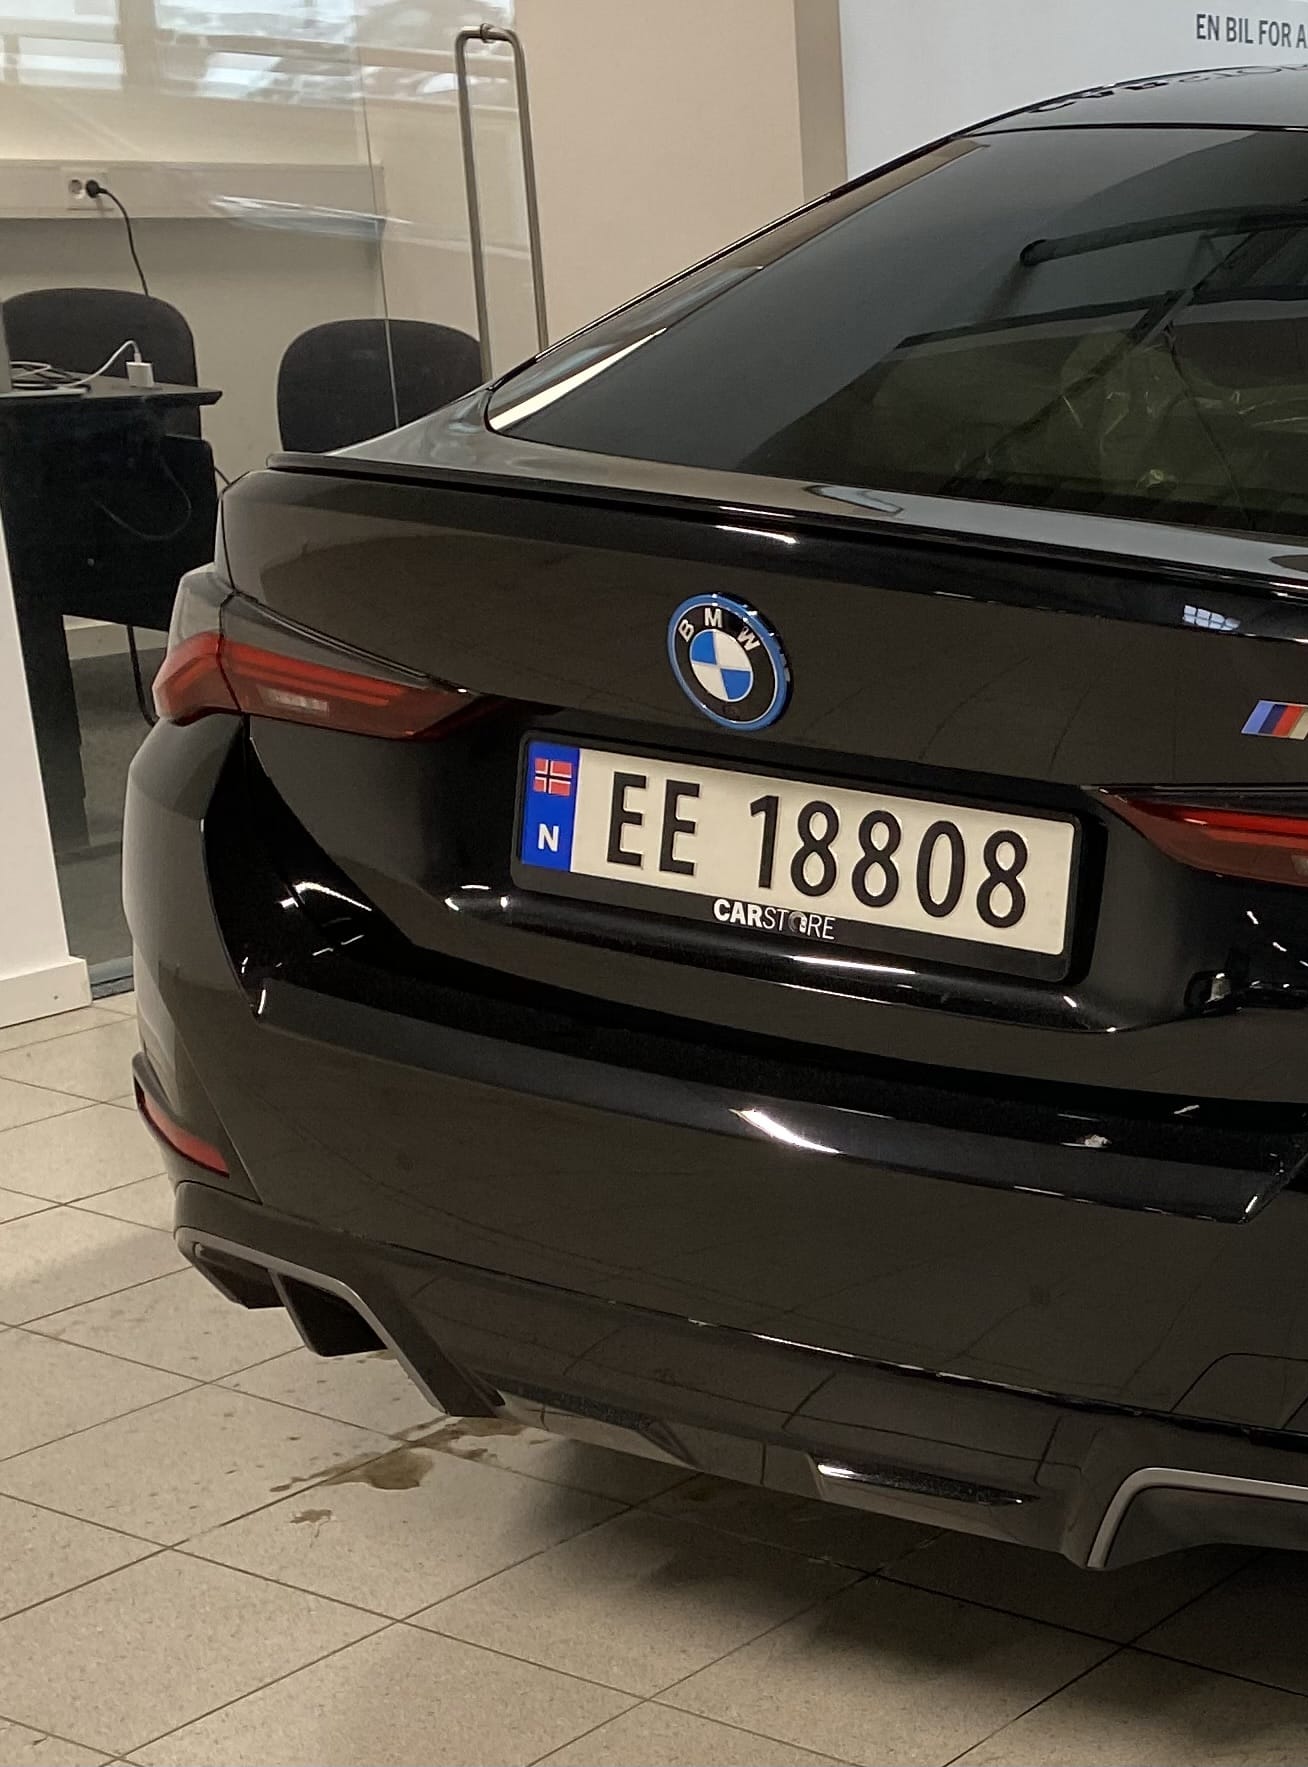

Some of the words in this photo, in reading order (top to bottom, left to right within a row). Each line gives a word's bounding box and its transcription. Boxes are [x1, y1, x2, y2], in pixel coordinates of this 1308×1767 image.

[1196, 13, 1220, 41] EN
[1225, 16, 1254, 44] BIL
[1258, 19, 1292, 48] FOR
[678, 607, 761, 651] BMW
[537, 823, 560, 853] N
[607, 770, 701, 876] EE
[748, 794, 1029, 929] 18808
[713, 898, 837, 940] CARSTORE
